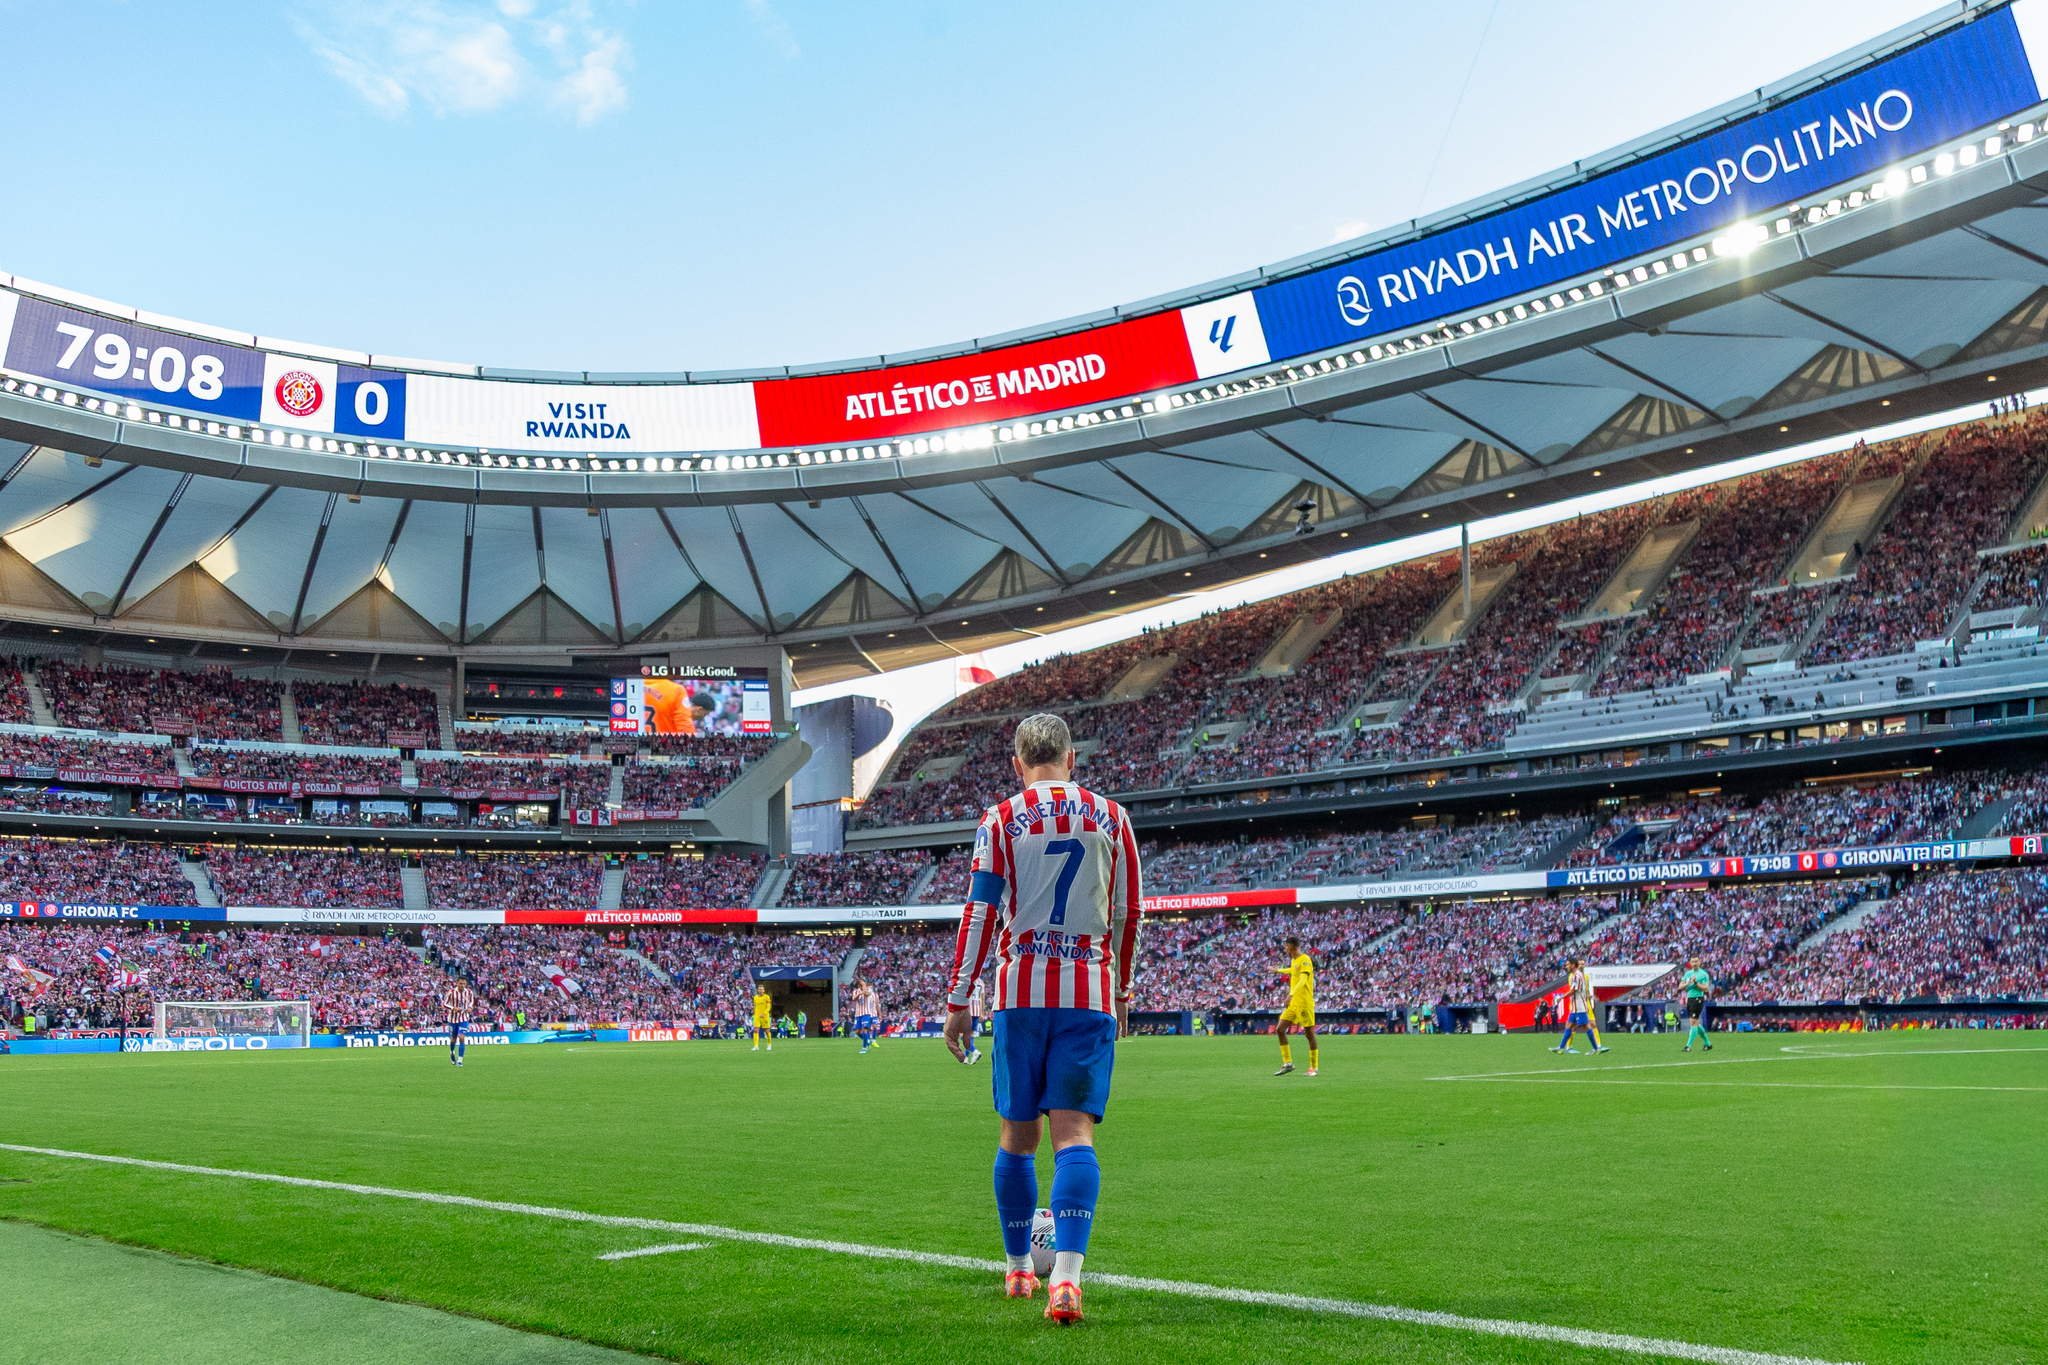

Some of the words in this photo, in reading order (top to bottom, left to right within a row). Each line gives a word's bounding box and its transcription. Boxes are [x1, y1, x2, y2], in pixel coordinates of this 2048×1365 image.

[1378, 235, 1519, 309] RIYADH
[1527, 212, 1595, 266] AIR
[1597, 89, 1913, 239] METROPOLITANO
[56, 321, 225, 401] 79:08
[283, 371, 317, 387] GIRONA
[846, 379, 969, 421] ATLÉTICO
[996, 353, 1106, 398] MADRID
[354, 381, 389, 426] 0
[548, 402, 607, 420] VISIT
[526, 421, 631, 439] RWANDA
[651, 665, 669, 677] LG
[680, 665, 706, 677] Life's
[706, 666, 737, 677] Good.
[630, 684, 636, 694] 1
[629, 705, 637, 714] 0
[612, 720, 637, 730] 79:08
[59, 770, 96, 782] CANILLAS
[101, 772, 141, 784] LORANCA
[223, 779, 265, 790] ADICTOS
[266, 781, 288, 791] ATM
[304, 782, 343, 793] COSLADA
[1005, 800, 1120, 838] GRIEZMANN
[1802, 854, 1813, 868] 0
[1842, 847, 1900, 866] GIRONA
[1730, 860, 1738, 874] 1
[1750, 856, 1791, 872] 79:08
[1566, 868, 1627, 885] ATLÉTICO
[1628, 866, 1647, 880] DE
[1648, 862, 1703, 879] MADRID
[1043, 838, 1086, 926] 7
[1366, 885, 1396, 895] RIYADH
[1398, 884, 1412, 893] AIR
[1414, 880, 1478, 892] METROPOLITANO
[0, 903, 13, 915] 8
[1142, 897, 1182, 910] ATLÉTICO
[1191, 895, 1228, 907] MADRID
[25, 904, 35, 916] 0
[62, 905, 118, 918] GIRONA
[121, 907, 139, 918] FC
[313, 911, 347, 920] RIYADH
[349, 911, 365, 920] AIR
[367, 912, 436, 921] METROPOLITANO
[585, 911, 632, 922] ATLÉTICO
[642, 913, 682, 922] MADRID
[851, 910, 907, 918] ALPHATAURI
[1032, 930, 1081, 946] VISIT
[1015, 942, 1094, 960] RWANDA
[343, 1035, 374, 1048] Tan
[377, 1034, 415, 1047] Polo
[465, 1035, 510, 1045] nunca
[632, 1030, 674, 1041] LALIGA
[1059, 1208, 1092, 1220] ATLETI
